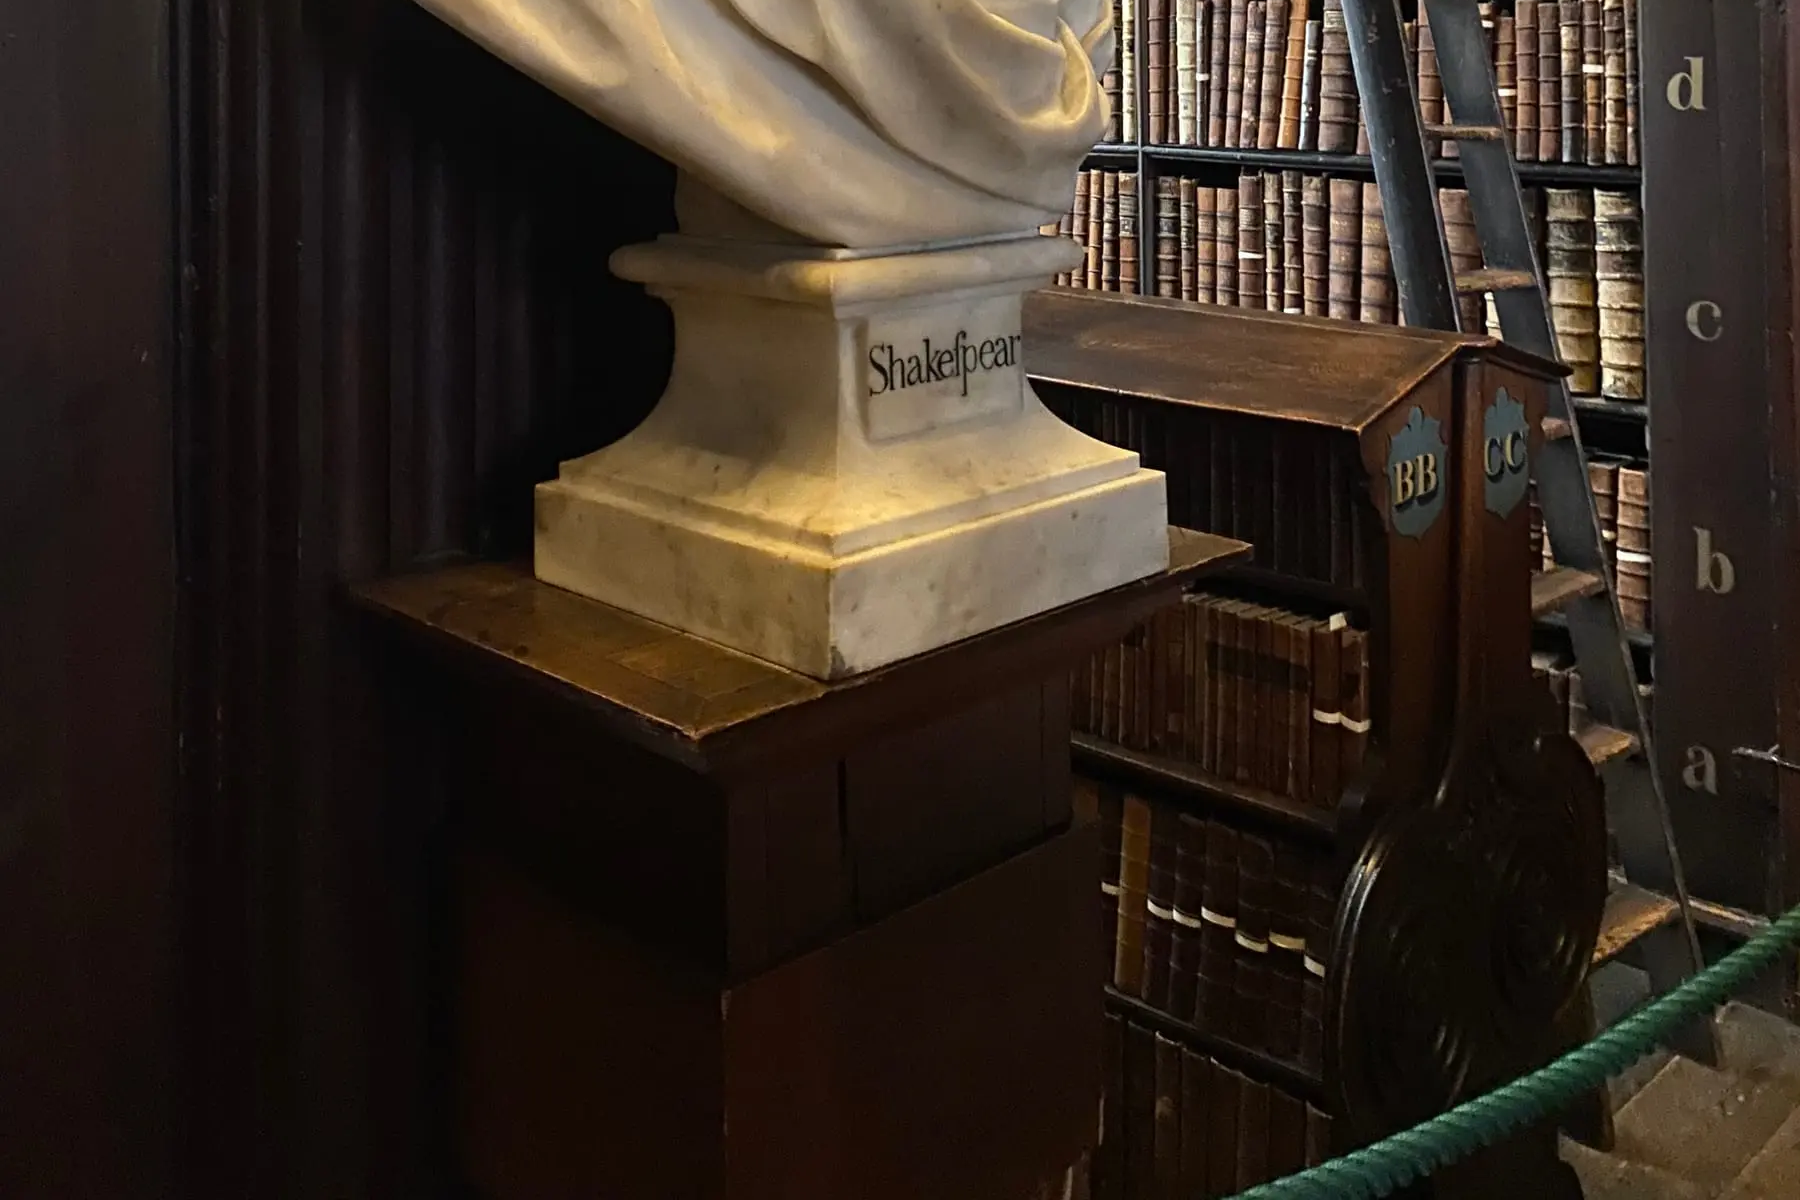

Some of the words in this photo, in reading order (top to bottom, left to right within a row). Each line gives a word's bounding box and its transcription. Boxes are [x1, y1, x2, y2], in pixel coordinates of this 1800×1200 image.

[1666, 56, 1706, 111] d
[1685, 300, 1722, 342] c
[1394, 453, 1438, 507] BB
[1484, 431, 1526, 479] CC
[1693, 525, 1735, 595] b
[1682, 745, 1718, 795] a
